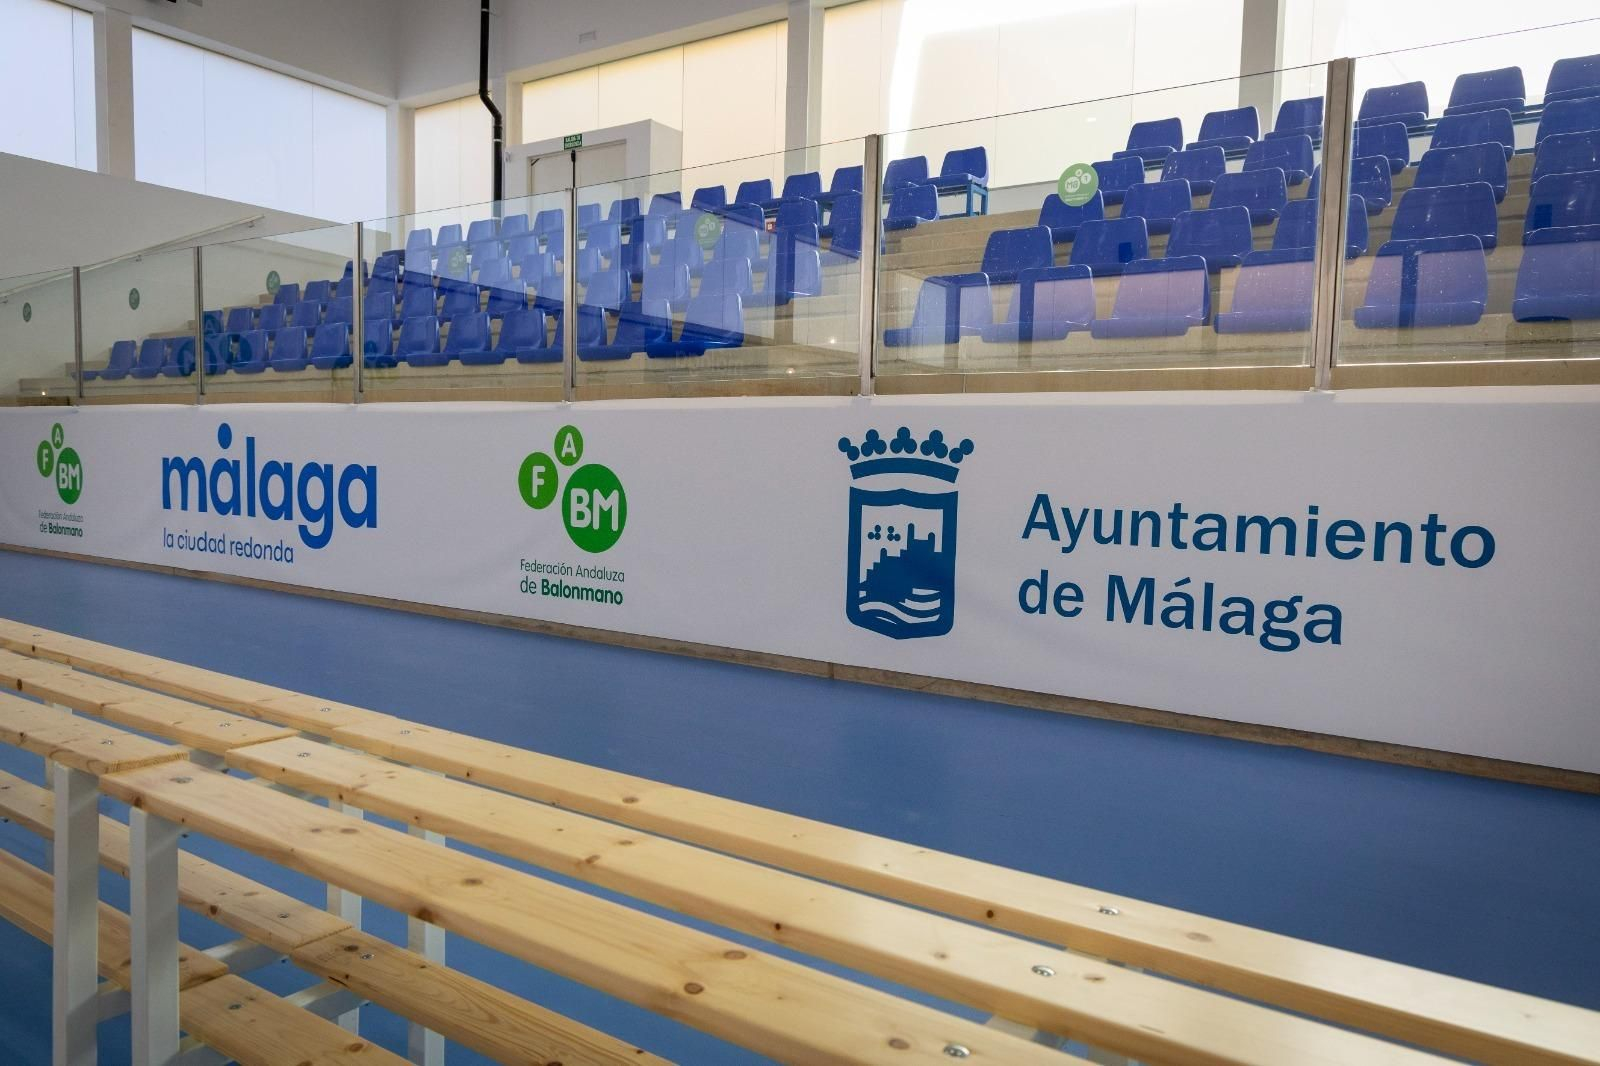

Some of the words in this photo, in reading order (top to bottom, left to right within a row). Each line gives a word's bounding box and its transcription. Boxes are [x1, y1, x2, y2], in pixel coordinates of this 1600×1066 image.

[54, 427, 62, 445] A
[561, 432, 577, 458] A
[42, 448, 49, 471] F
[58, 462, 80, 491] BM
[531, 465, 546, 498] F
[570, 487, 620, 532] BM
[39, 521, 48, 533] de
[48, 522, 83, 538] Balonmano
[1021, 493, 1496, 569] Ayuntamiento
[163, 527, 174, 548] la
[177, 529, 226, 555] ciudad
[230, 536, 294, 564] redonda
[520, 558, 573, 577] Federación
[575, 564, 625, 583] Andaluza
[520, 575, 537, 594] de
[541, 578, 624, 606] Balonmano
[1018, 569, 1084, 618] de
[1106, 574, 1343, 653] Málaga
